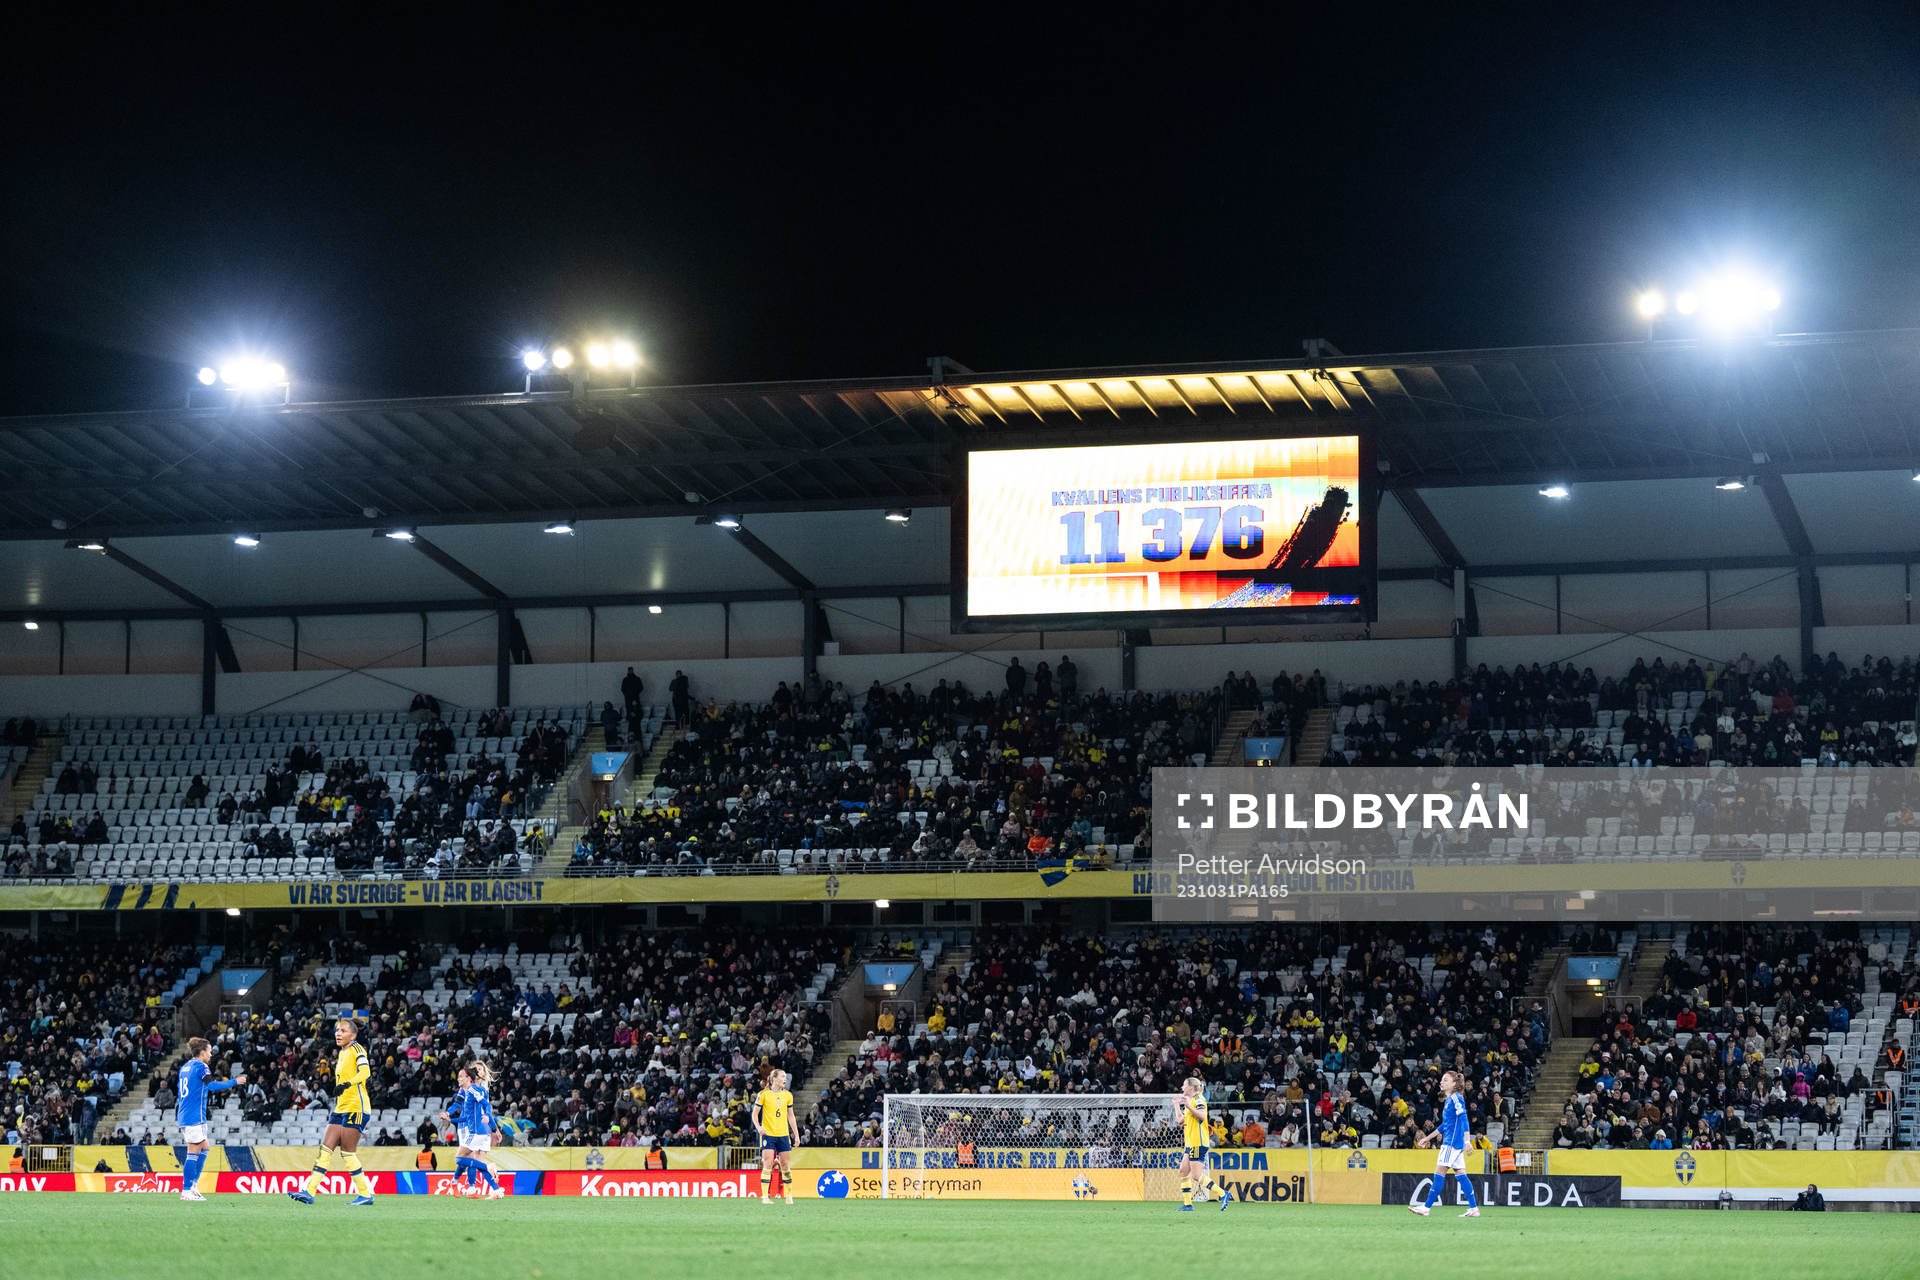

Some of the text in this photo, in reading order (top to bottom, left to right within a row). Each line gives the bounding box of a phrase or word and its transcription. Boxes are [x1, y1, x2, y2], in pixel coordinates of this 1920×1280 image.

[1146, 483, 1273, 503] PUBLIKSIFFRA
[1060, 504, 1264, 564] 11 376
[1325, 869, 1415, 892] HISTORIA
[289, 885, 306, 904] VI
[309, 883, 332, 904] ÄR
[336, 883, 406, 903] SVERIGE
[422, 883, 440, 902] VI
[443, 881, 467, 902] ÄR
[470, 880, 544, 902] BLÅGULT
[775, 1109, 781, 1117] 6
[924, 1151, 1023, 1169] SKIVS
[852, 1176, 982, 1194] Steve Perryman
